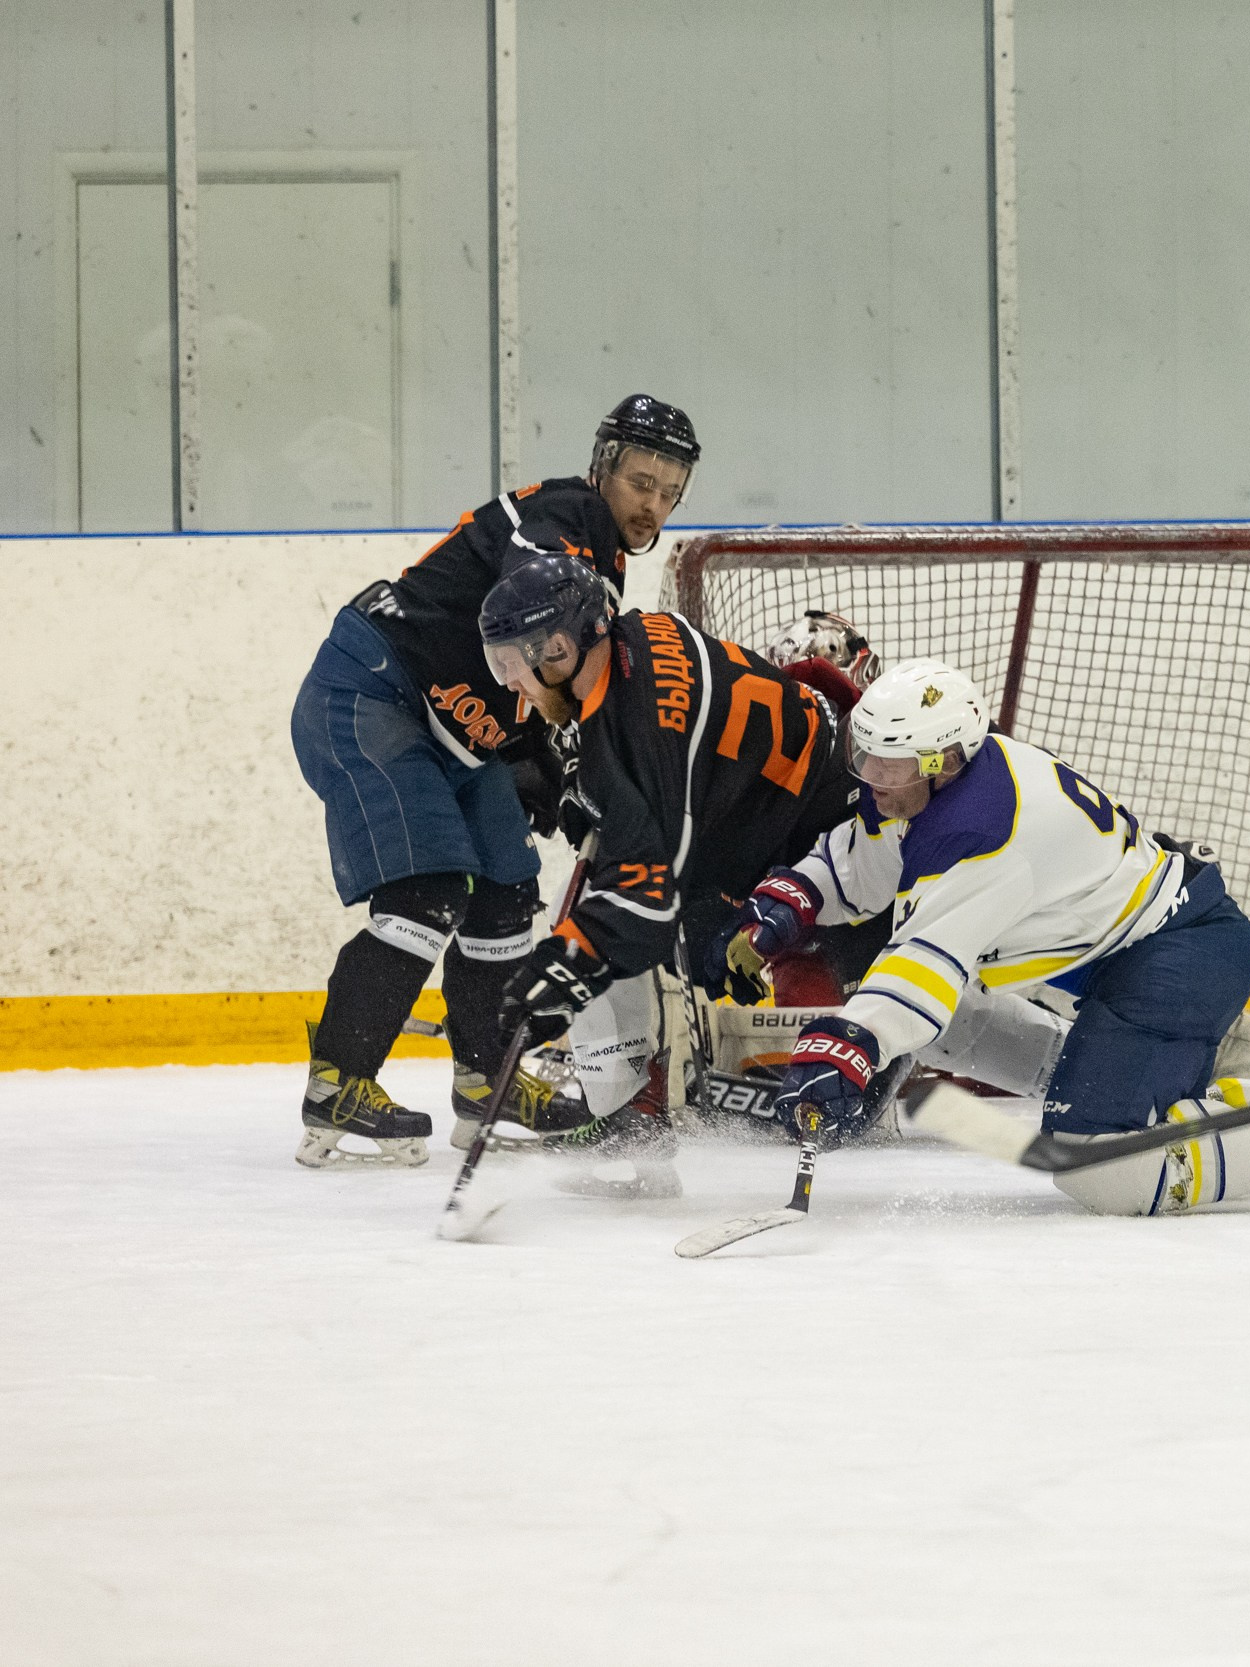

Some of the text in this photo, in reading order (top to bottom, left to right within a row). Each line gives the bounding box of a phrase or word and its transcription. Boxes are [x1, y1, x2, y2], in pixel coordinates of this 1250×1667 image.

[936, 726, 962, 743] CCM
[754, 878, 812, 910] UER
[545, 961, 595, 1007] CC
[752, 1012, 828, 1028] BAUE
[792, 1038, 872, 1083] BAUER
[1043, 1100, 1073, 1114] CM
[797, 1141, 818, 1176] CCM
